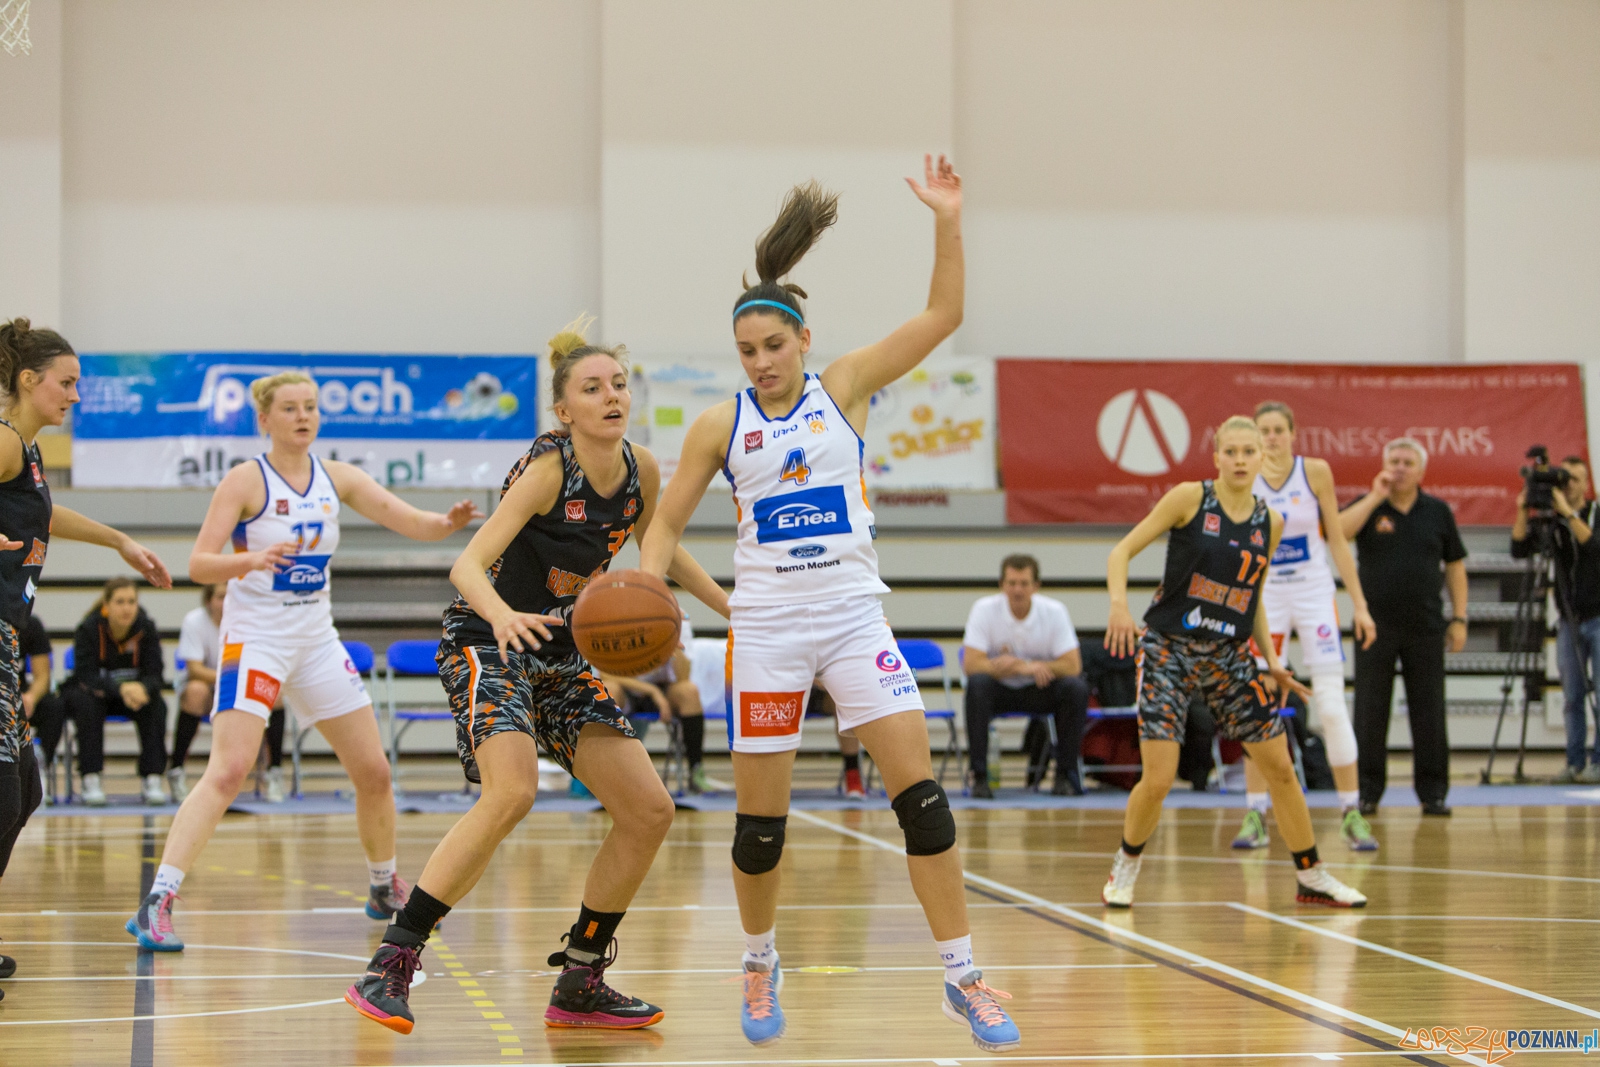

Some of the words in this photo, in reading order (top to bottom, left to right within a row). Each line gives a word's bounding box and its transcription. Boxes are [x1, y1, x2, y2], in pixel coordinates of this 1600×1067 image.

[778, 447, 811, 486] 4
[777, 511, 837, 530] Enea
[290, 521, 324, 551] 17
[795, 547, 820, 557] Ford
[776, 563, 806, 574] Bemo
[807, 559, 841, 571] Motors
[1236, 549, 1268, 586] 17
[546, 566, 589, 598] BASKE
[750, 708, 796, 721] SZPIKU
